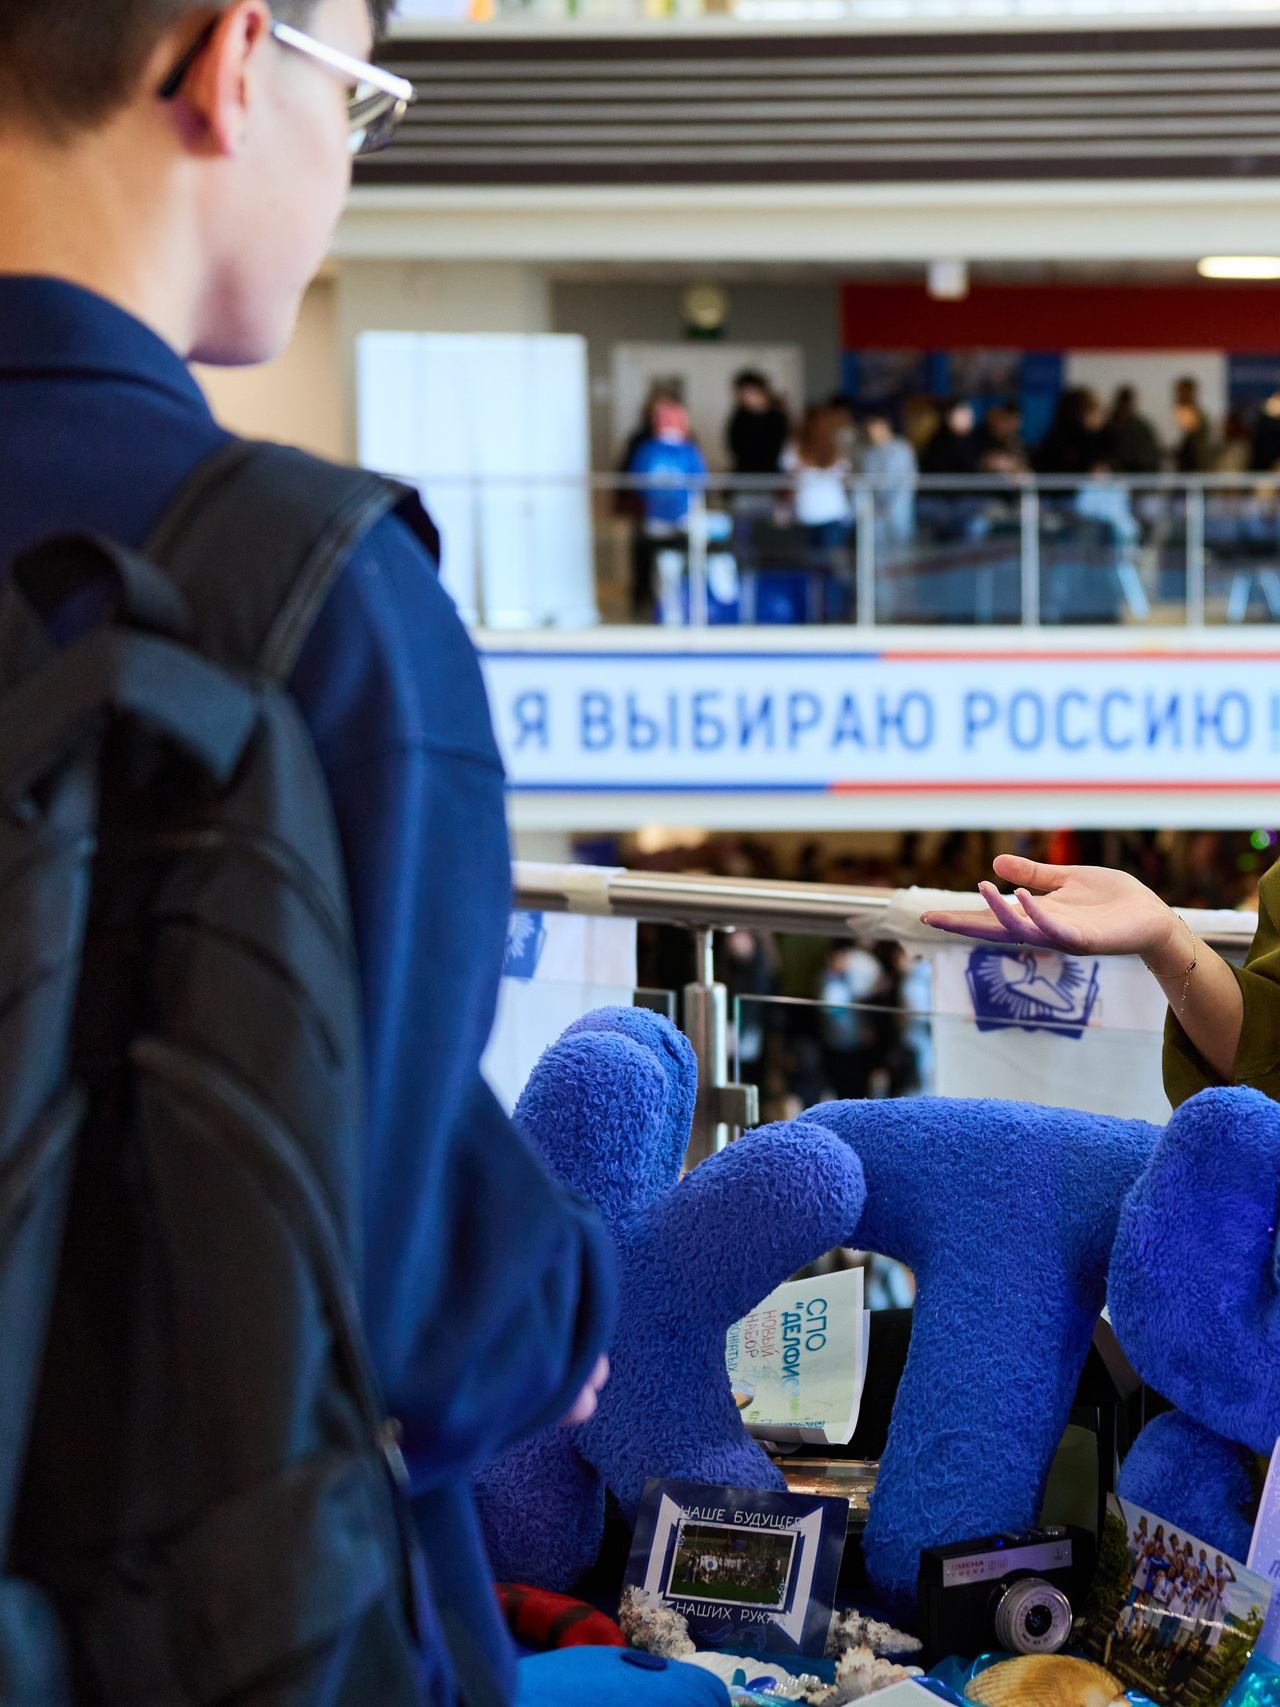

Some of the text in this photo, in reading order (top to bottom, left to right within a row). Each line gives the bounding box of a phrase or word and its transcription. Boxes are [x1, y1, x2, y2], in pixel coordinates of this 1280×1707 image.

[512, 689, 552, 751] Я
[577, 689, 937, 752] ВЫБИРАЮ
[744, 1313, 760, 1358] НАБОР
[762, 1310, 780, 1358] НОВЫЙ
[805, 1298, 827, 1351] СПО
[681, 1505, 726, 1521] НАШЕ
[675, 1602, 732, 1620] НАШИХ
